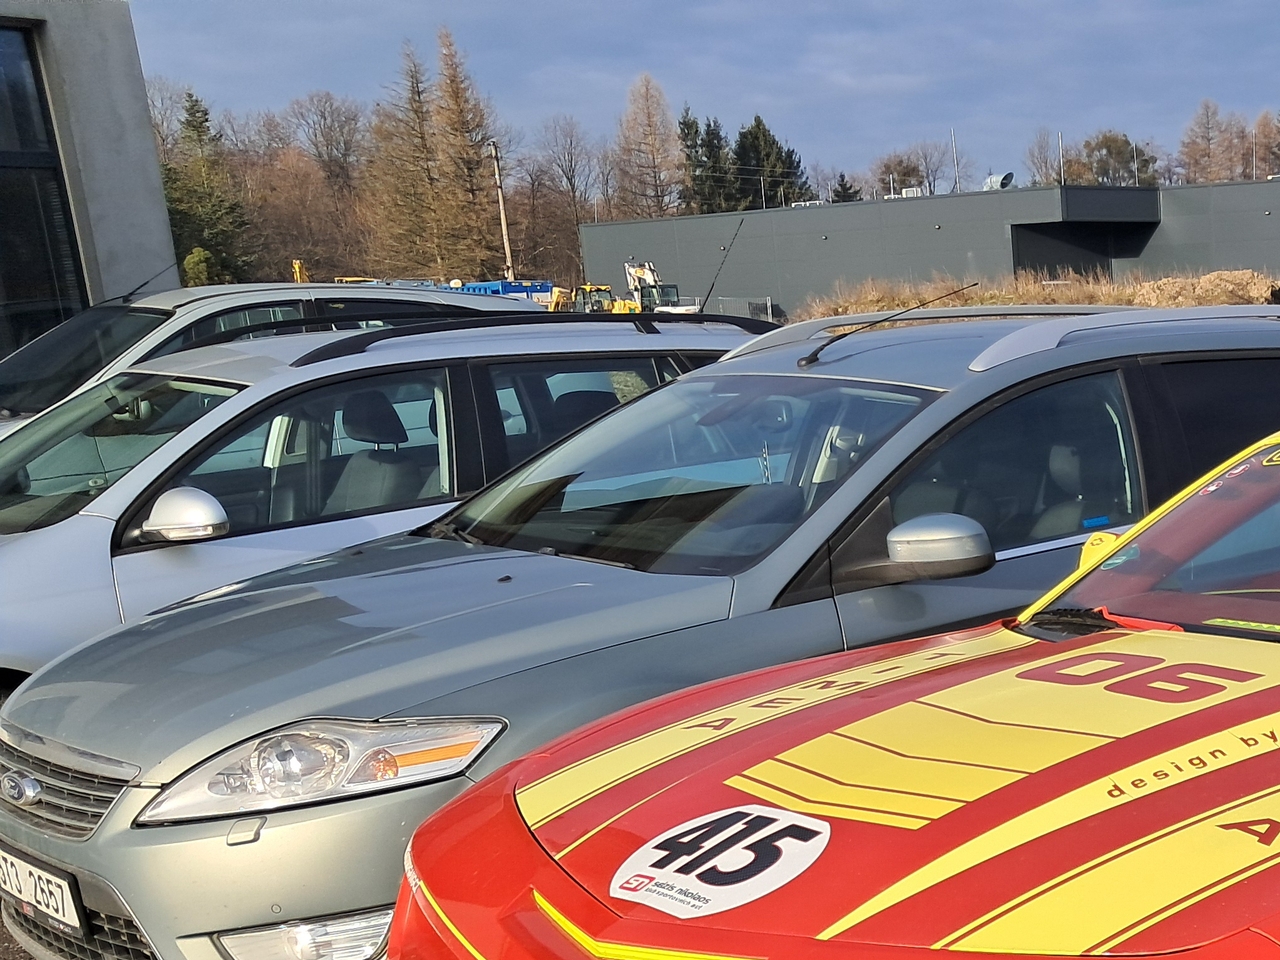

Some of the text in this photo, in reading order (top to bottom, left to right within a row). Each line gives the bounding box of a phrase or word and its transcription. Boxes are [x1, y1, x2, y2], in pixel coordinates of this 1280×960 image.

[1106, 748, 1228, 799] design
[1239, 728, 1279, 749] by
[648, 811, 823, 887] 415
[28, 869, 66, 918] 2657
